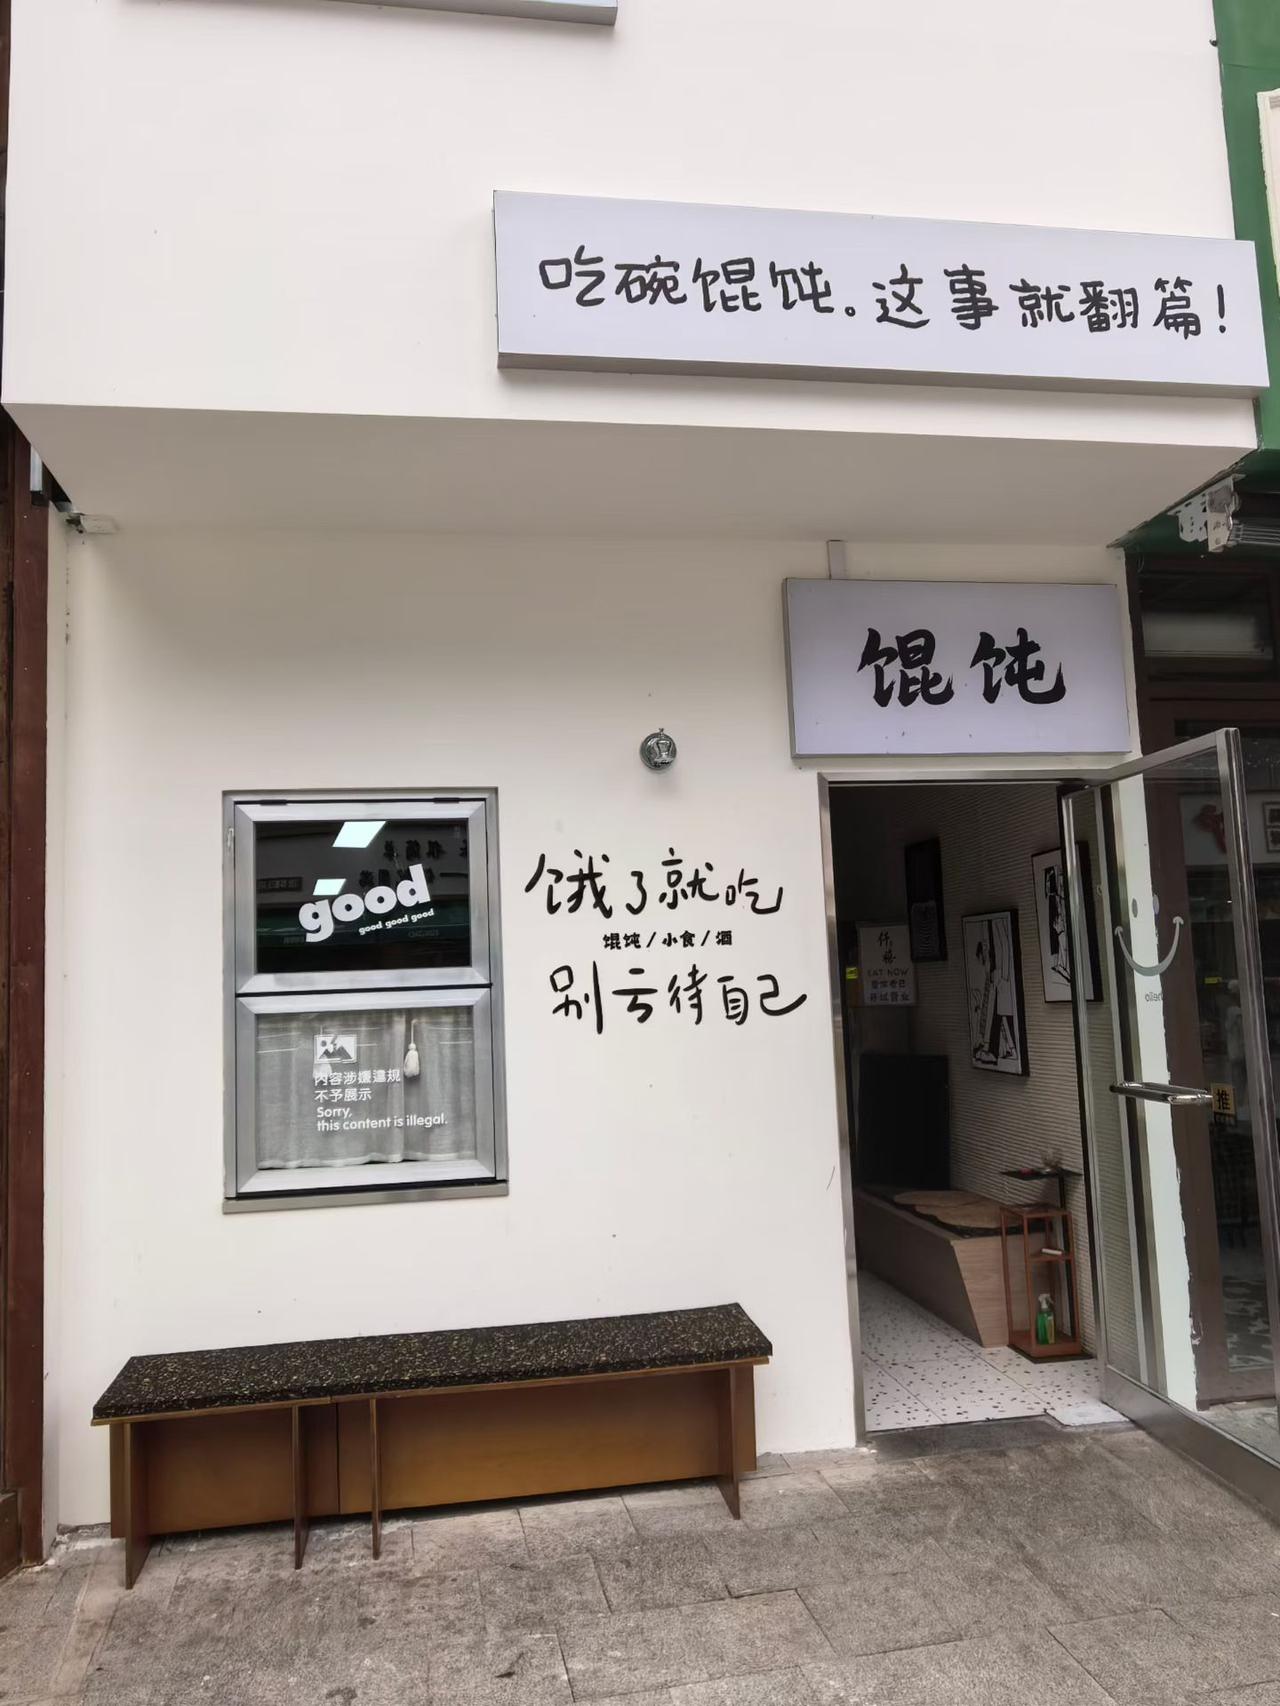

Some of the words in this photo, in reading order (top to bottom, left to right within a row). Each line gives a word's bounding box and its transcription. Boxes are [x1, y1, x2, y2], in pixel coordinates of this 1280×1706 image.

[856, 627, 1067, 708] 馄饨
[524, 847, 784, 919] 饿了就吃
[298, 863, 431, 942] good
[358, 921, 383, 936] good
[385, 914, 409, 929] good
[411, 908, 435, 923] good
[549, 960, 808, 1035] 别亏待自己
[314, 1088, 373, 1103] 不予展示
[1216, 1089, 1231, 1111] 推
[316, 1106, 353, 1119] Sorry,
[316, 1120, 340, 1132] this
[342, 1116, 392, 1131] content
[393, 1115, 404, 1127] is
[406, 1112, 449, 1128] illegal.
